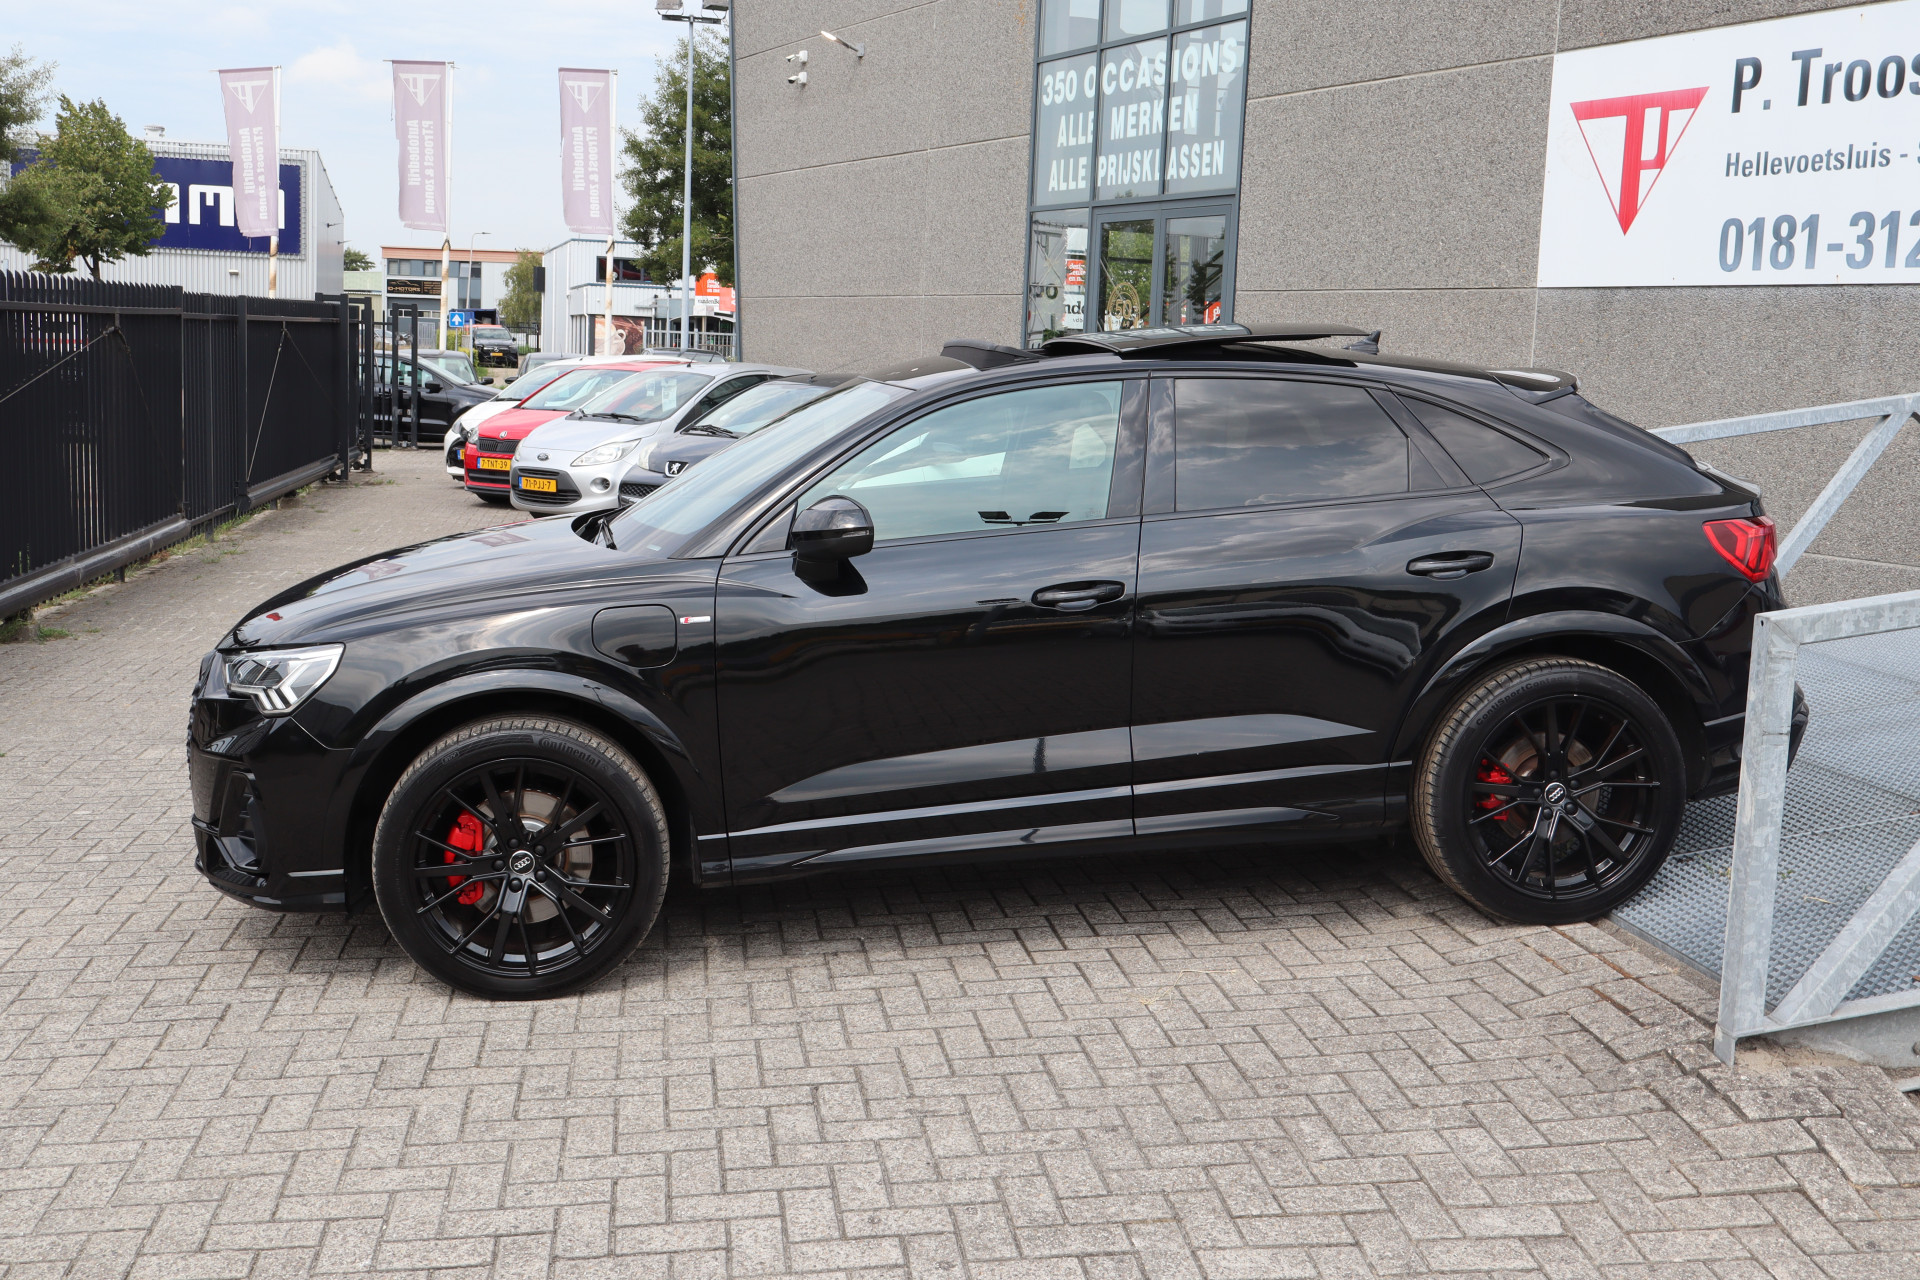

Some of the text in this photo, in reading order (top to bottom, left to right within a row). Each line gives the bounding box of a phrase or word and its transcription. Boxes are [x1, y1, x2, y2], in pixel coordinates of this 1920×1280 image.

[1042, 37, 1238, 106] 350 OCCASIONS
[1731, 56, 1771, 113] P.
[1057, 93, 1198, 148] ALLE MERKEN
[1048, 140, 1225, 192] ALLE PRIJSKLASSEN
[1725, 142, 1891, 177] Hellevoetsluis
[1719, 208, 1920, 273] 0181-312
[481, 460, 508, 469] 7-TNT-39
[525, 478, 552, 490] 71-PJJ-7
[538, 737, 601, 768] Continental
